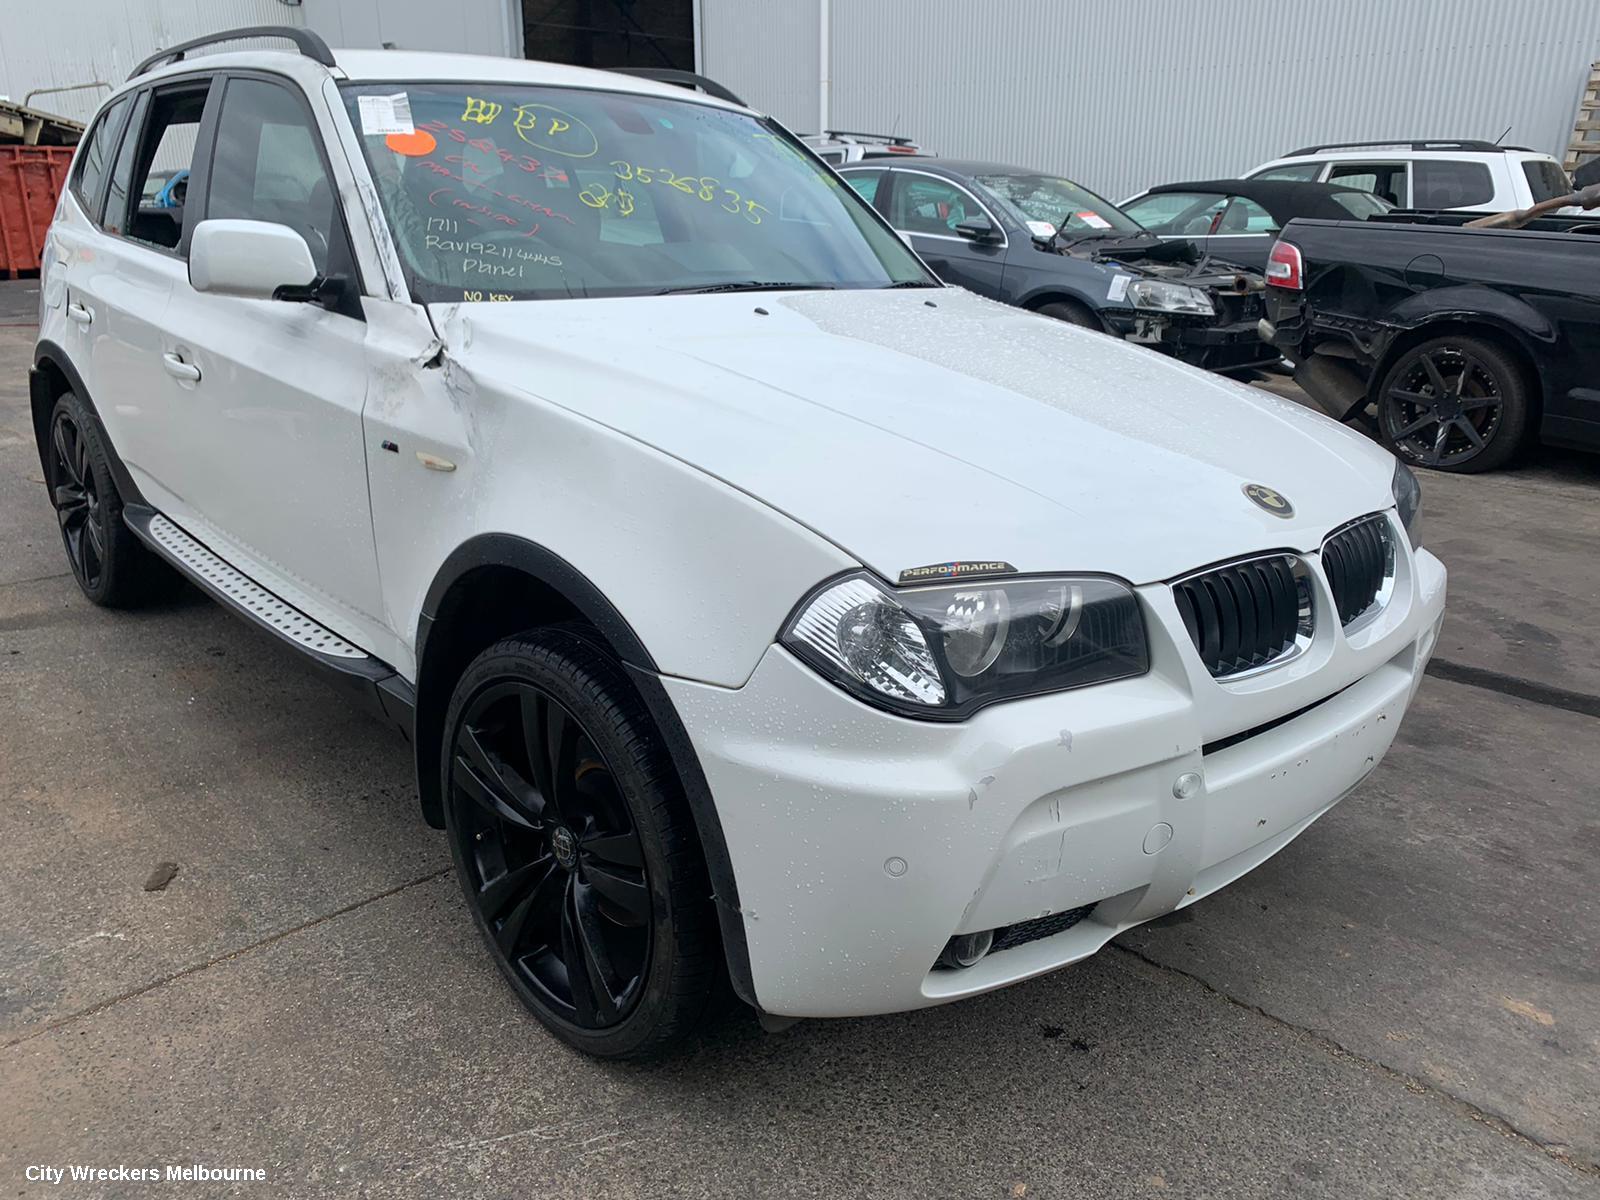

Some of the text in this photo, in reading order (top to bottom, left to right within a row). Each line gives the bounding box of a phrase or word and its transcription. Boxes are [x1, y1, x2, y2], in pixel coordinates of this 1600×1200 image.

[463, 290, 514, 303] NO KEY
[903, 562, 1005, 577] PERFORMANCE
